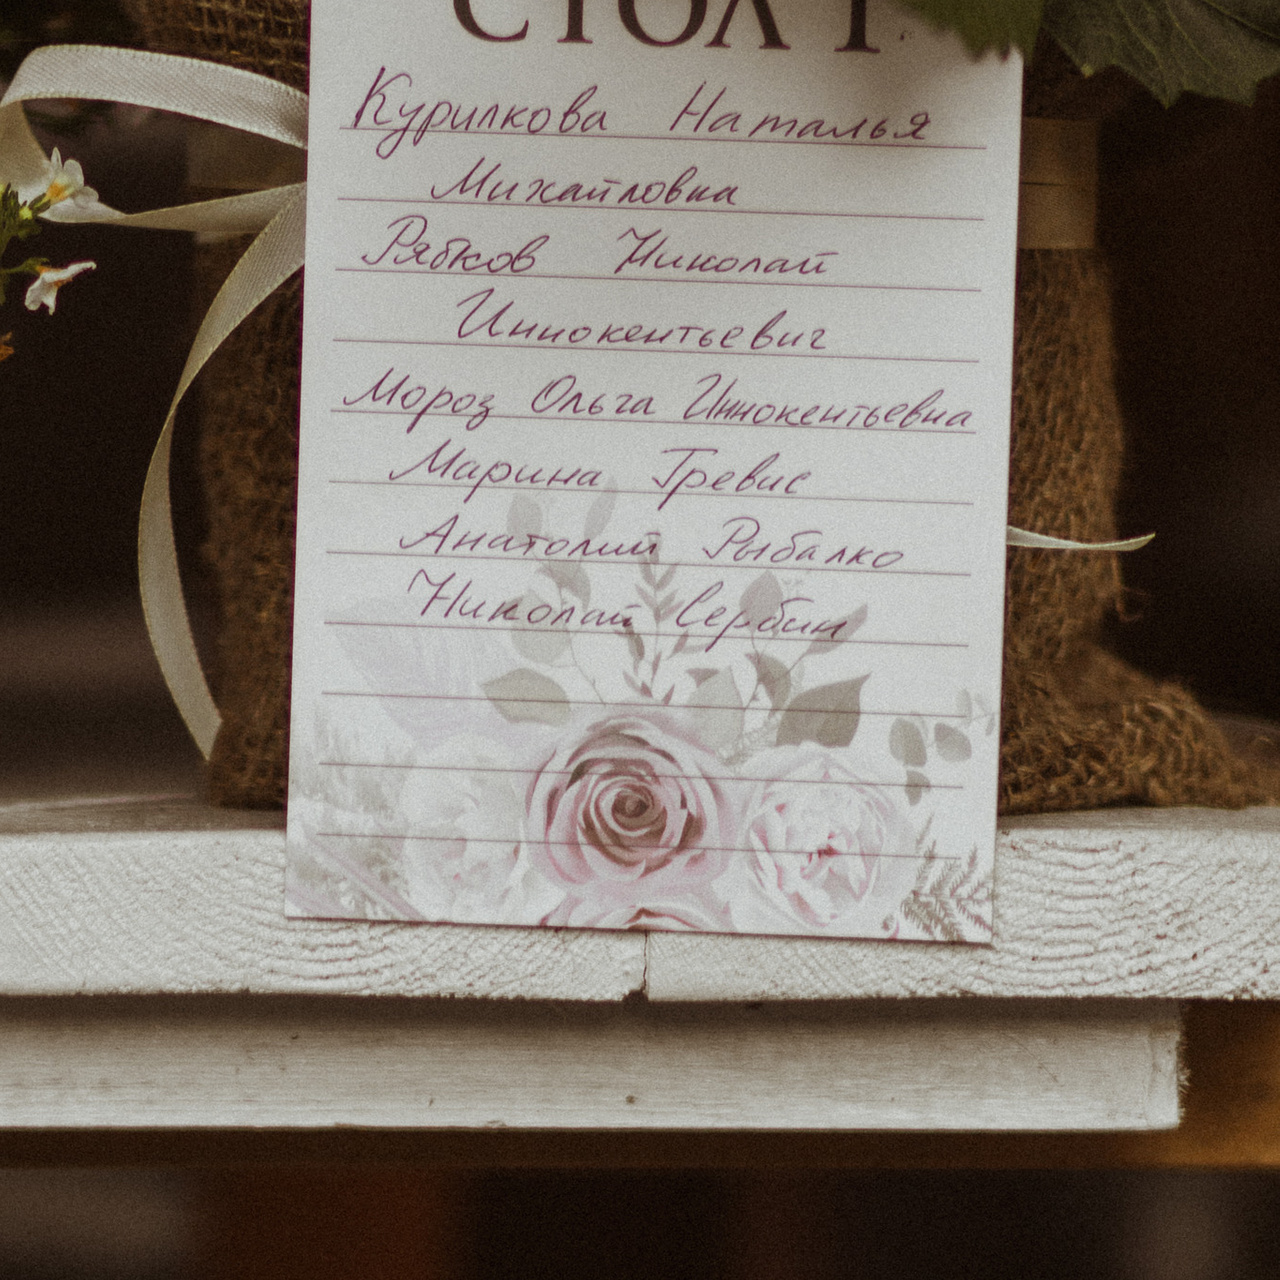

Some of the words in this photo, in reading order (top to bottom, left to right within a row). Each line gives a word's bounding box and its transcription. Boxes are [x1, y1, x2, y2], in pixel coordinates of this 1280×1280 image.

[352, 65, 608, 160] Курилкова
[669, 79, 932, 142] Наталья
[430, 157, 738, 207] Михайловна
[361, 214, 550, 274] Рябков
[614, 227, 840, 277] Николай
[455, 287, 829, 351] Иннокентьевич
[343, 367, 496, 434] Мороз
[530, 374, 657, 418] Ольга
[682, 372, 975, 432] Иннокентьевна
[388, 438, 601, 504] Марина
[399, 513, 662, 556] Анатолий
[700, 515, 905, 569] Рыбалко
[407, 568, 636, 629] Николай
[675, 580, 849, 652] Сербин
